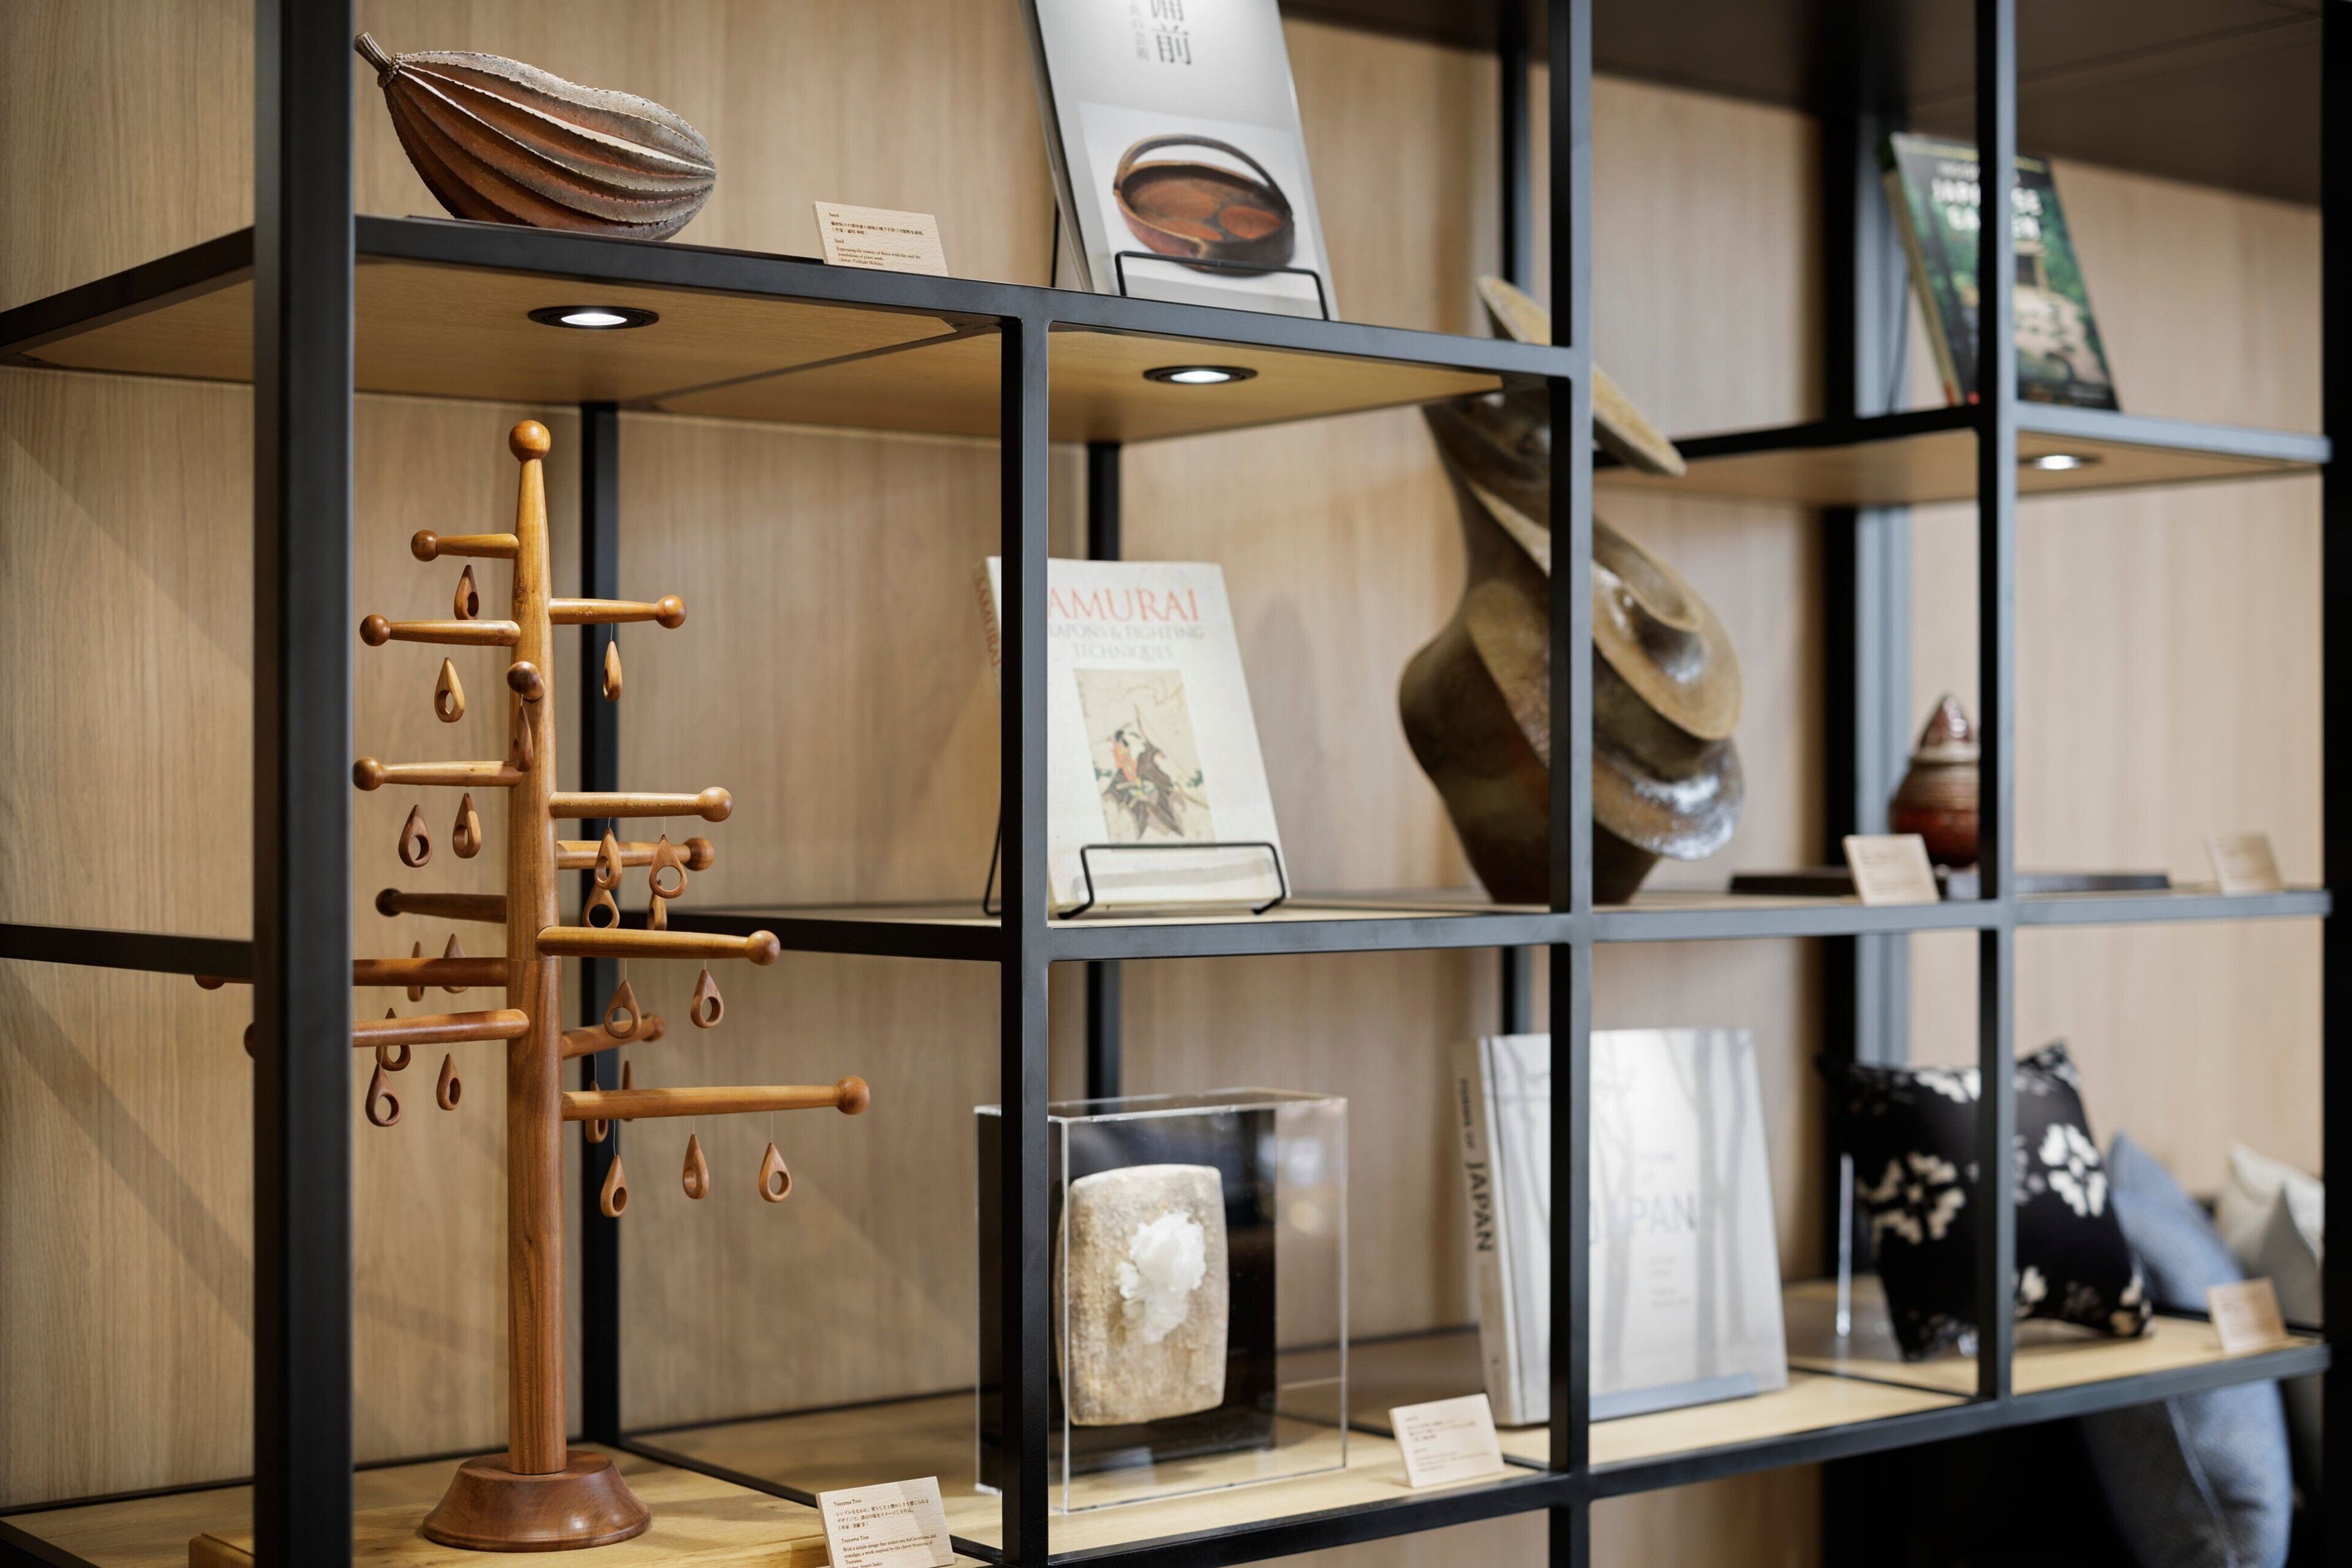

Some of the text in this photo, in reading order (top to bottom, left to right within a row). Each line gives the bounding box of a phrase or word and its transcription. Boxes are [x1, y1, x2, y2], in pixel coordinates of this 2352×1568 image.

[1048, 587, 1199, 622] AMURAI
[1048, 623, 1107, 638] EAPONS
[1466, 1161, 1493, 1251] JAPAN
